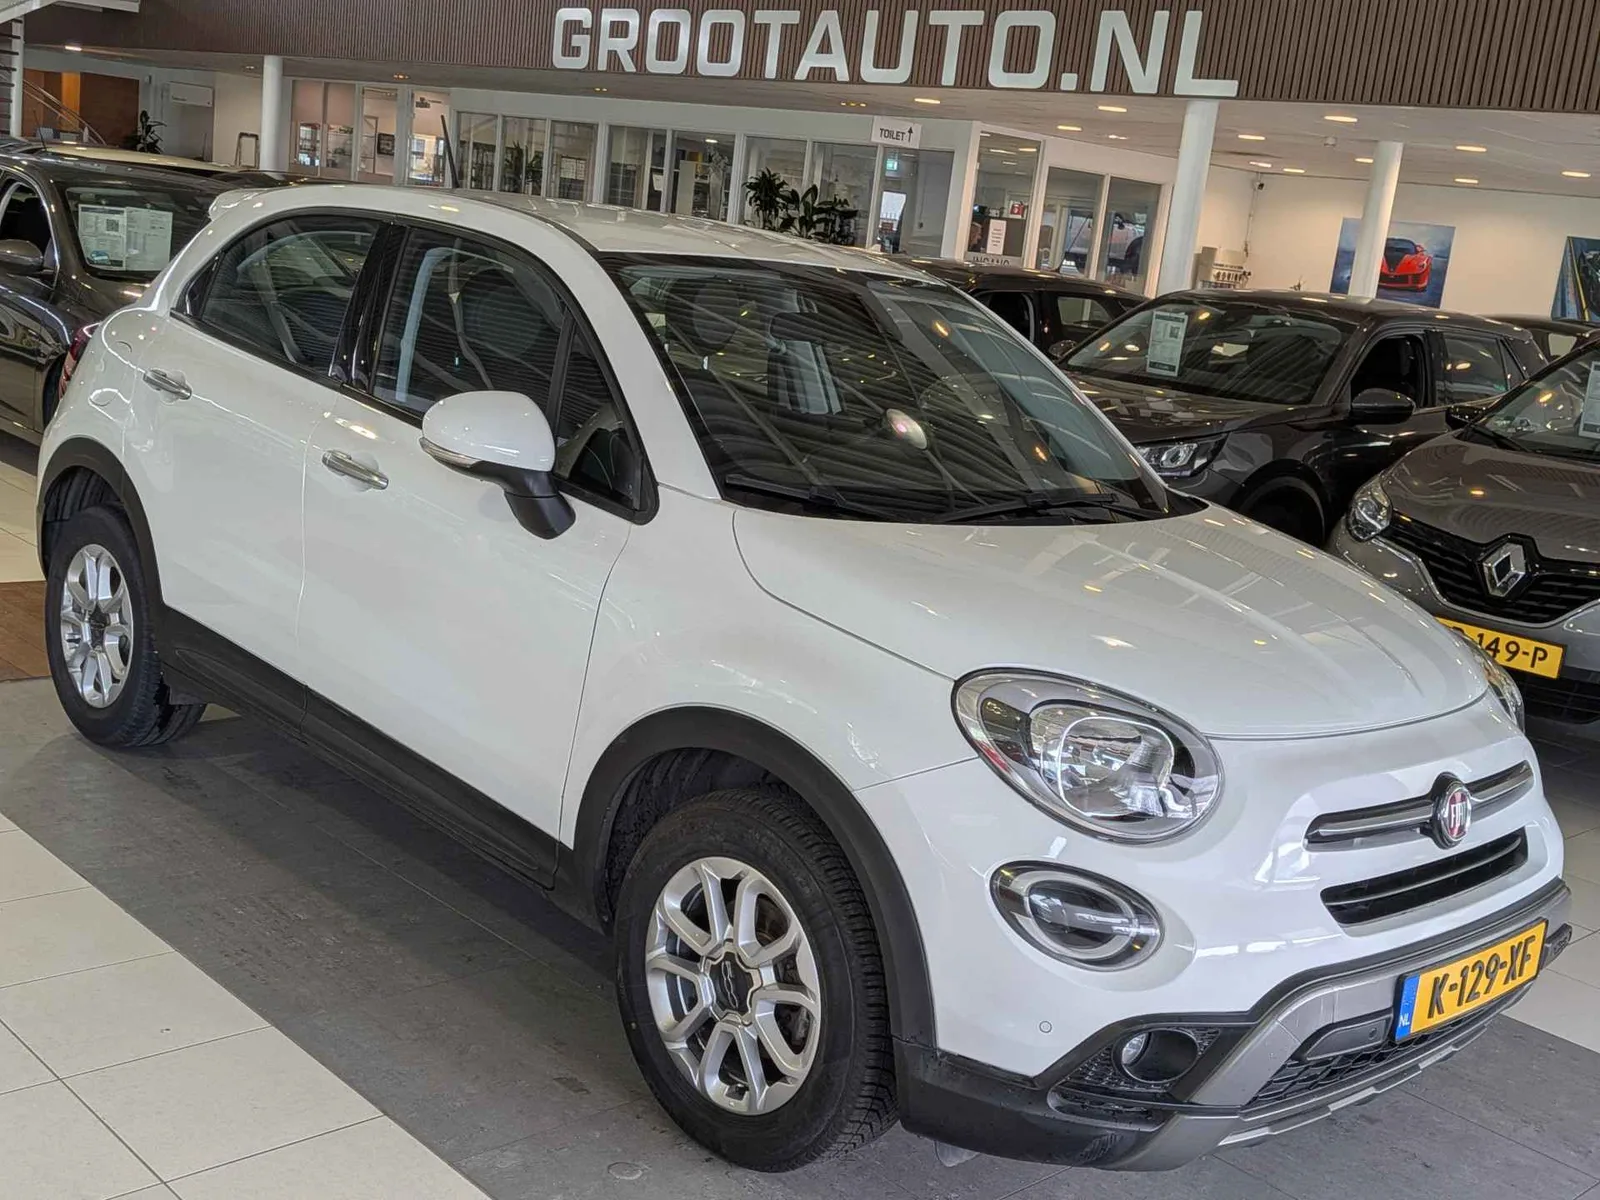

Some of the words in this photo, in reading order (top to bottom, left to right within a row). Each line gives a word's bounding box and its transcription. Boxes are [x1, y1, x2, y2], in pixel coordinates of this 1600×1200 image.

[552, 8, 1239, 97] GROOTAUTO.NL
[879, 127, 906, 141] TOILET
[1427, 935, 1536, 1019] K-129-XF
[1399, 1013, 1410, 1027] NL
